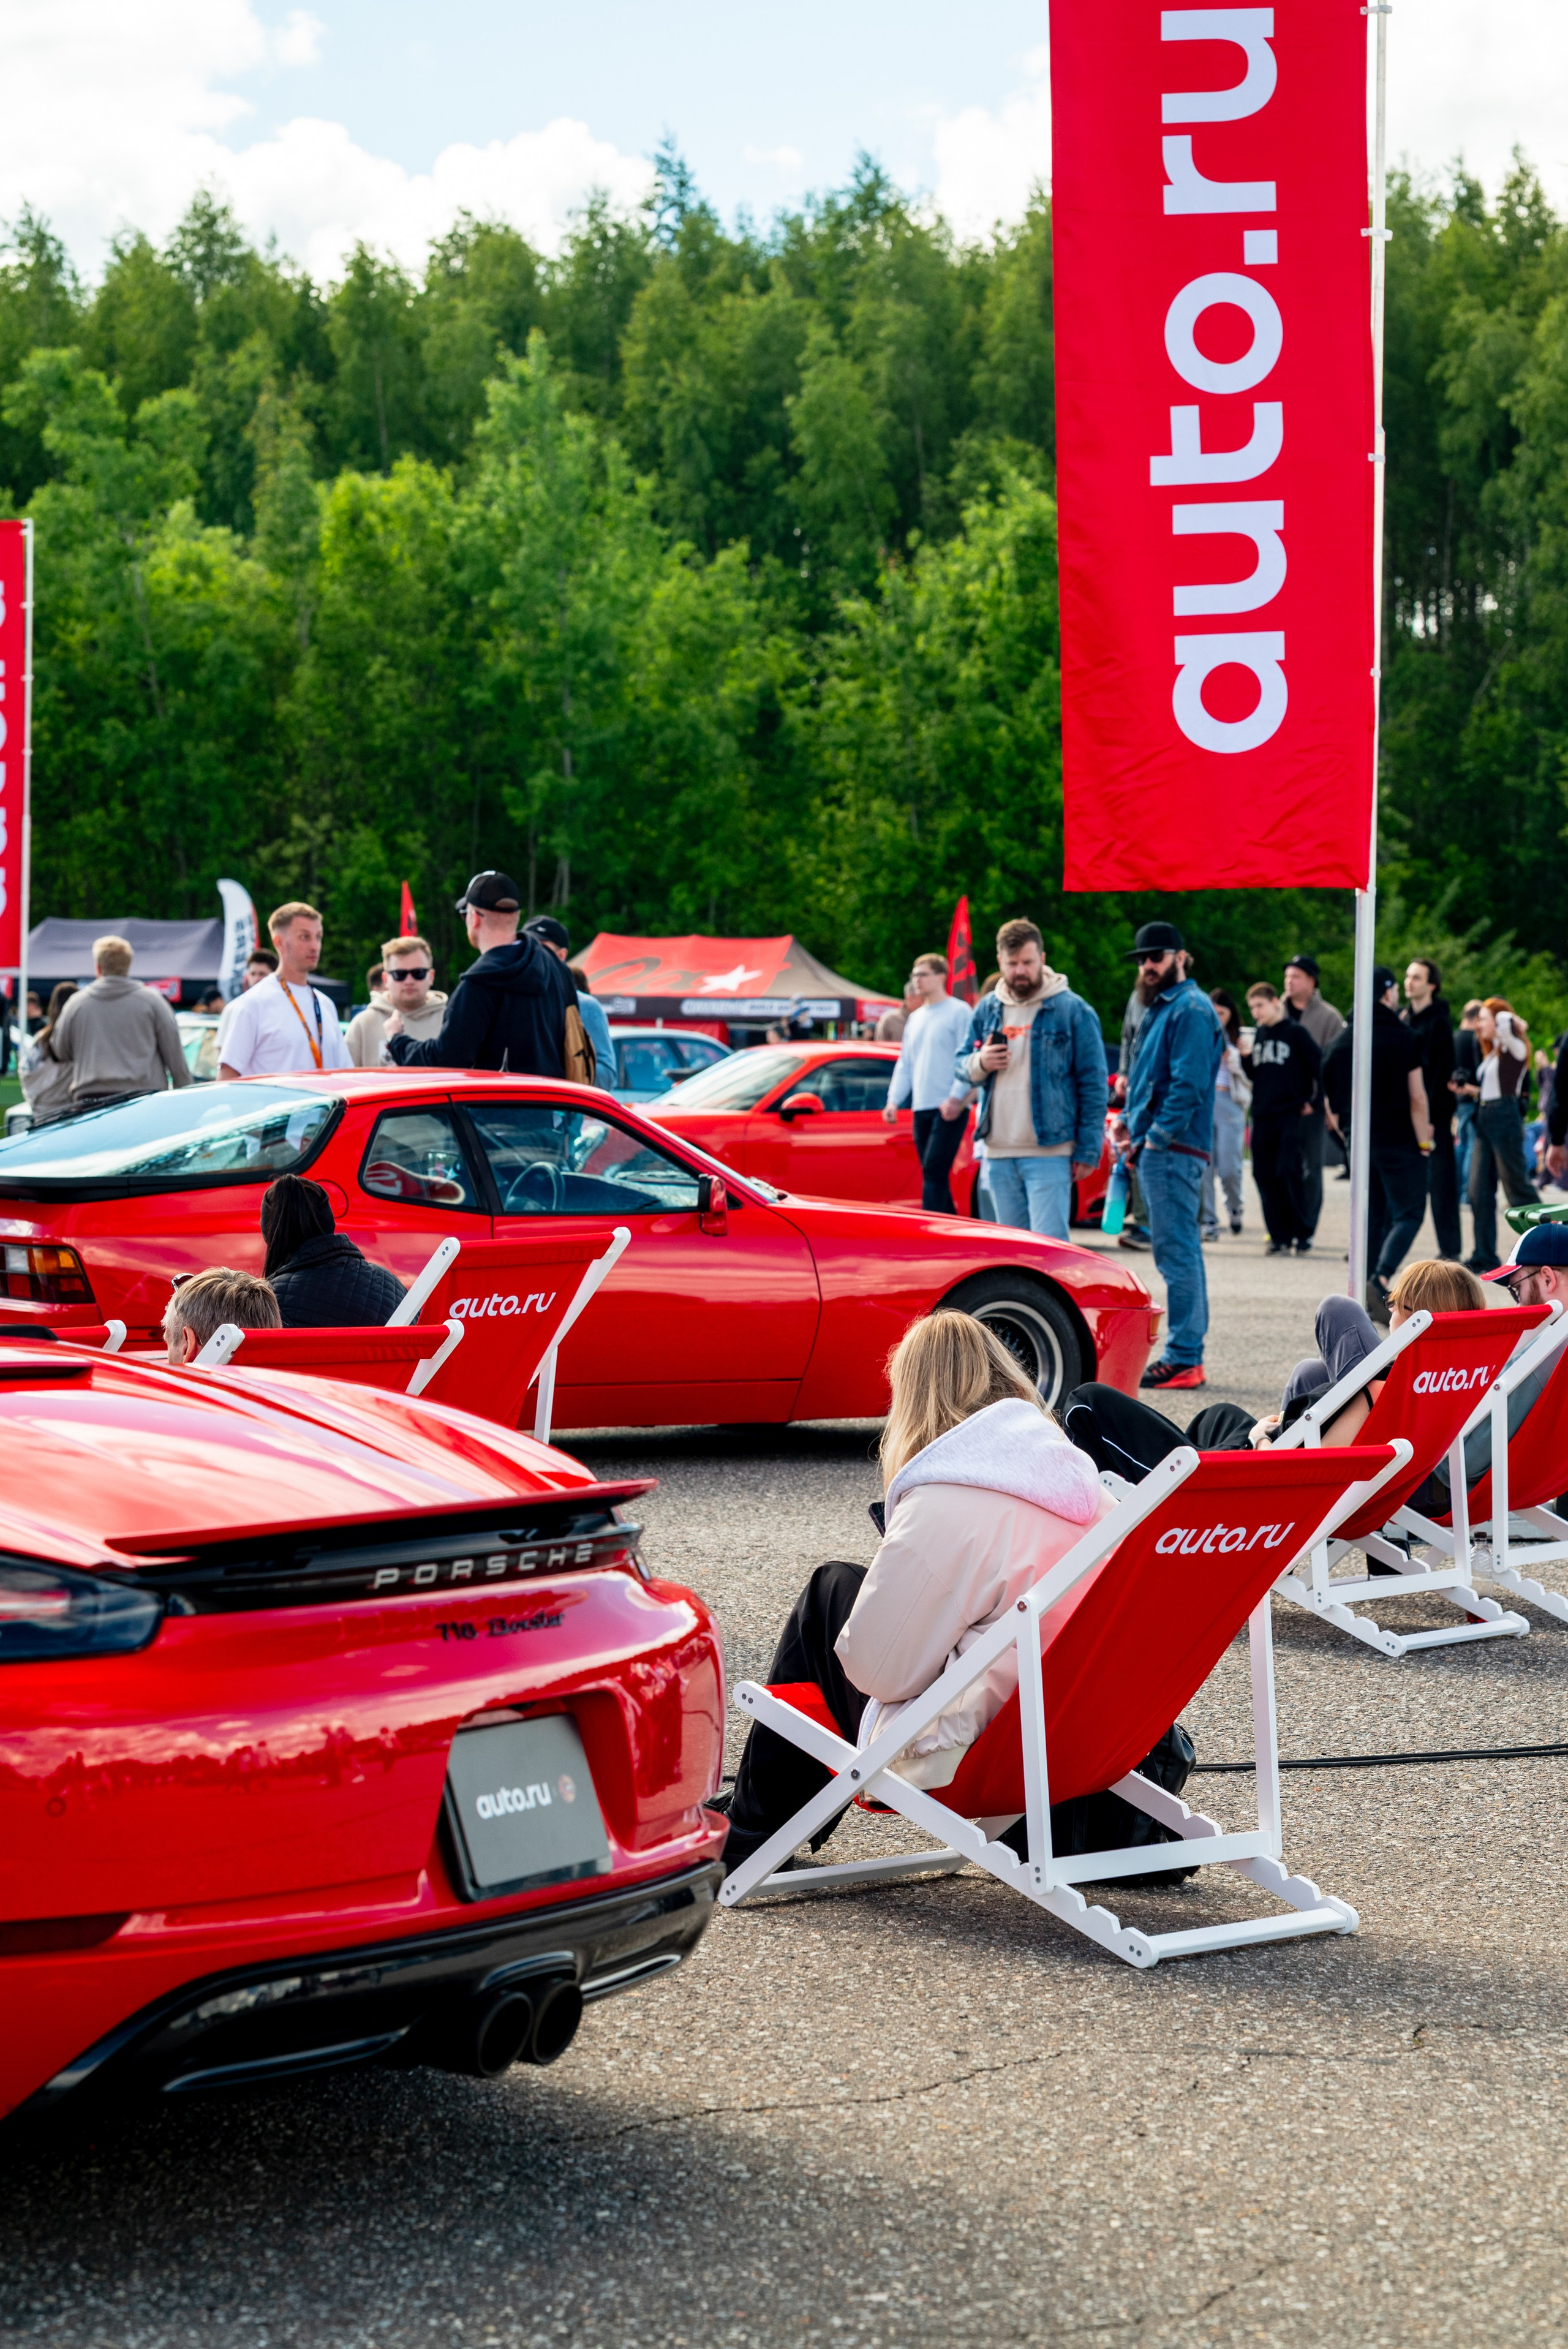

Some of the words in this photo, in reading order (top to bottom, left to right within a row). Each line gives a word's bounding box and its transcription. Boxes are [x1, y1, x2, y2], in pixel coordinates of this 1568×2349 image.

[1150, 7, 1288, 754] auto.ru
[449, 1292, 557, 1319] auto.ru
[1412, 1364, 1496, 1394] auto.ru
[1155, 1521, 1295, 1555] auto.ru
[373, 1542, 595, 1589] PORSCHE
[434, 1621, 478, 1642] 718
[475, 1781, 552, 1820] auto.ru
